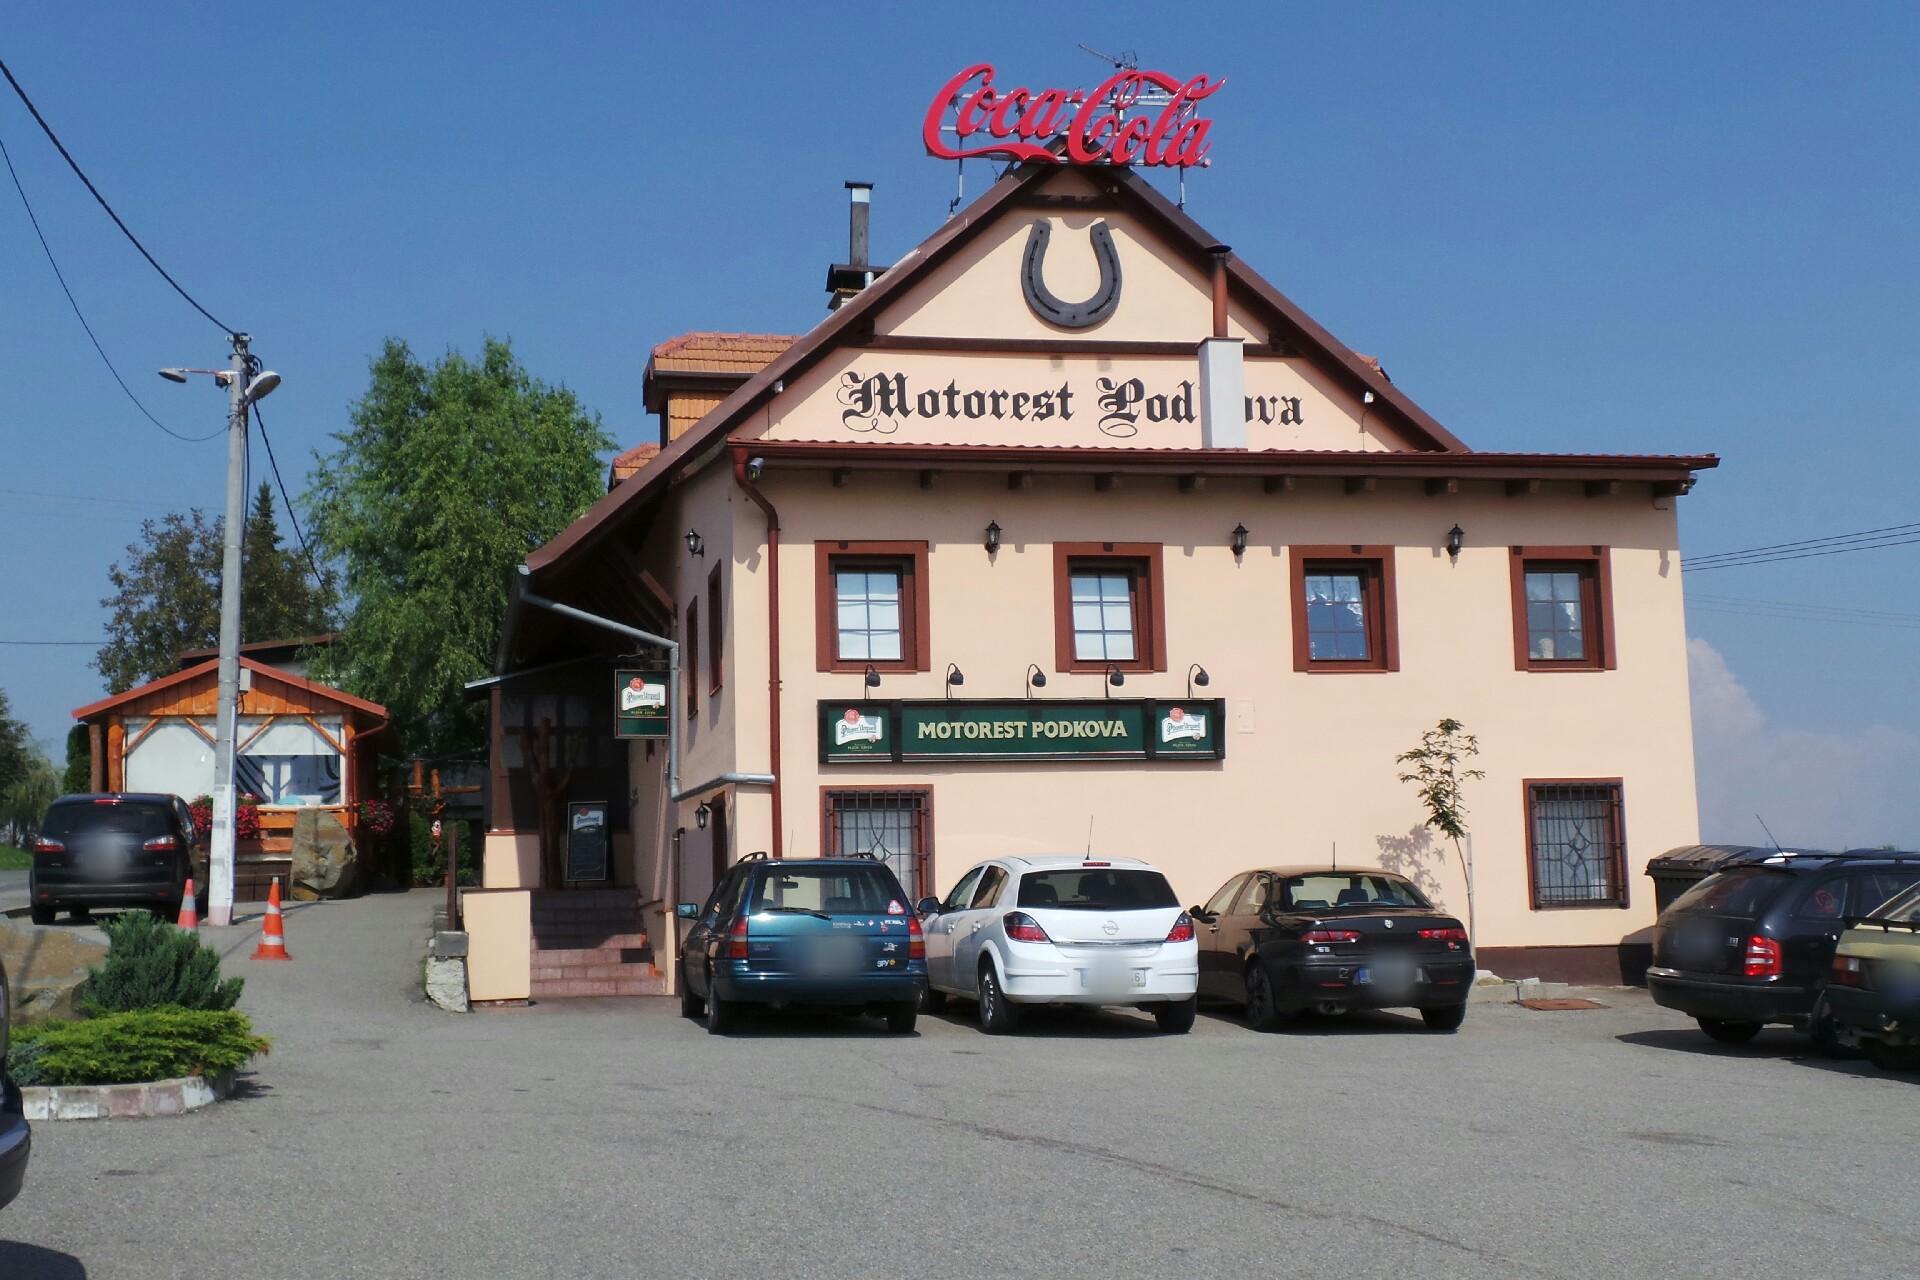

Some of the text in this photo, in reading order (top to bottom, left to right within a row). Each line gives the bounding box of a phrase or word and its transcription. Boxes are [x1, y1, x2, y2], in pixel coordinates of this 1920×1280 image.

[836, 371, 1304, 438] Motorest Podva
[917, 720, 1128, 739] MOTOREST PODKOVA
